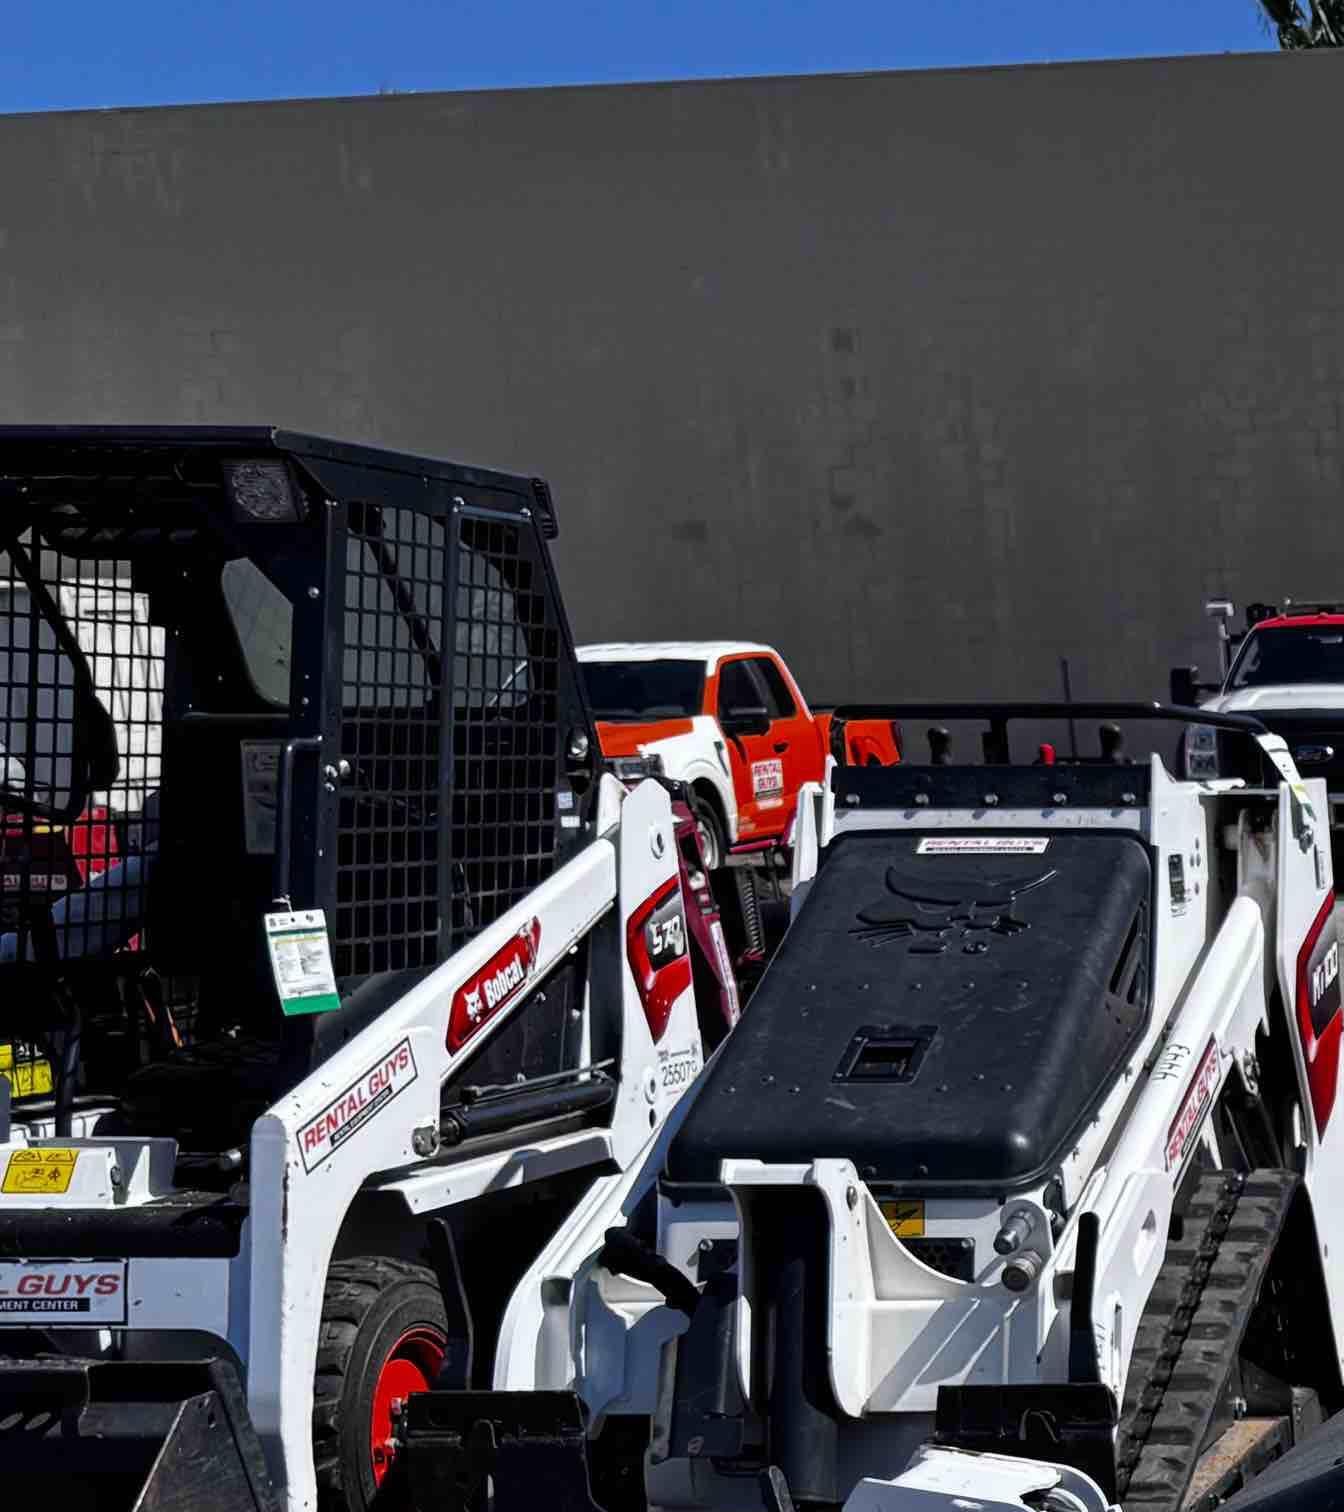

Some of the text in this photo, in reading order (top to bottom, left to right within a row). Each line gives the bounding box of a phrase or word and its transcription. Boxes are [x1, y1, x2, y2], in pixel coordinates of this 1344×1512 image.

[483, 952, 525, 1009] Bobcat
[304, 1087, 368, 1153] RENTAL
[368, 1047, 409, 1097] GUYS
[17, 1274, 120, 1296] GUYS
[32, 1300, 79, 1311] CENTER
